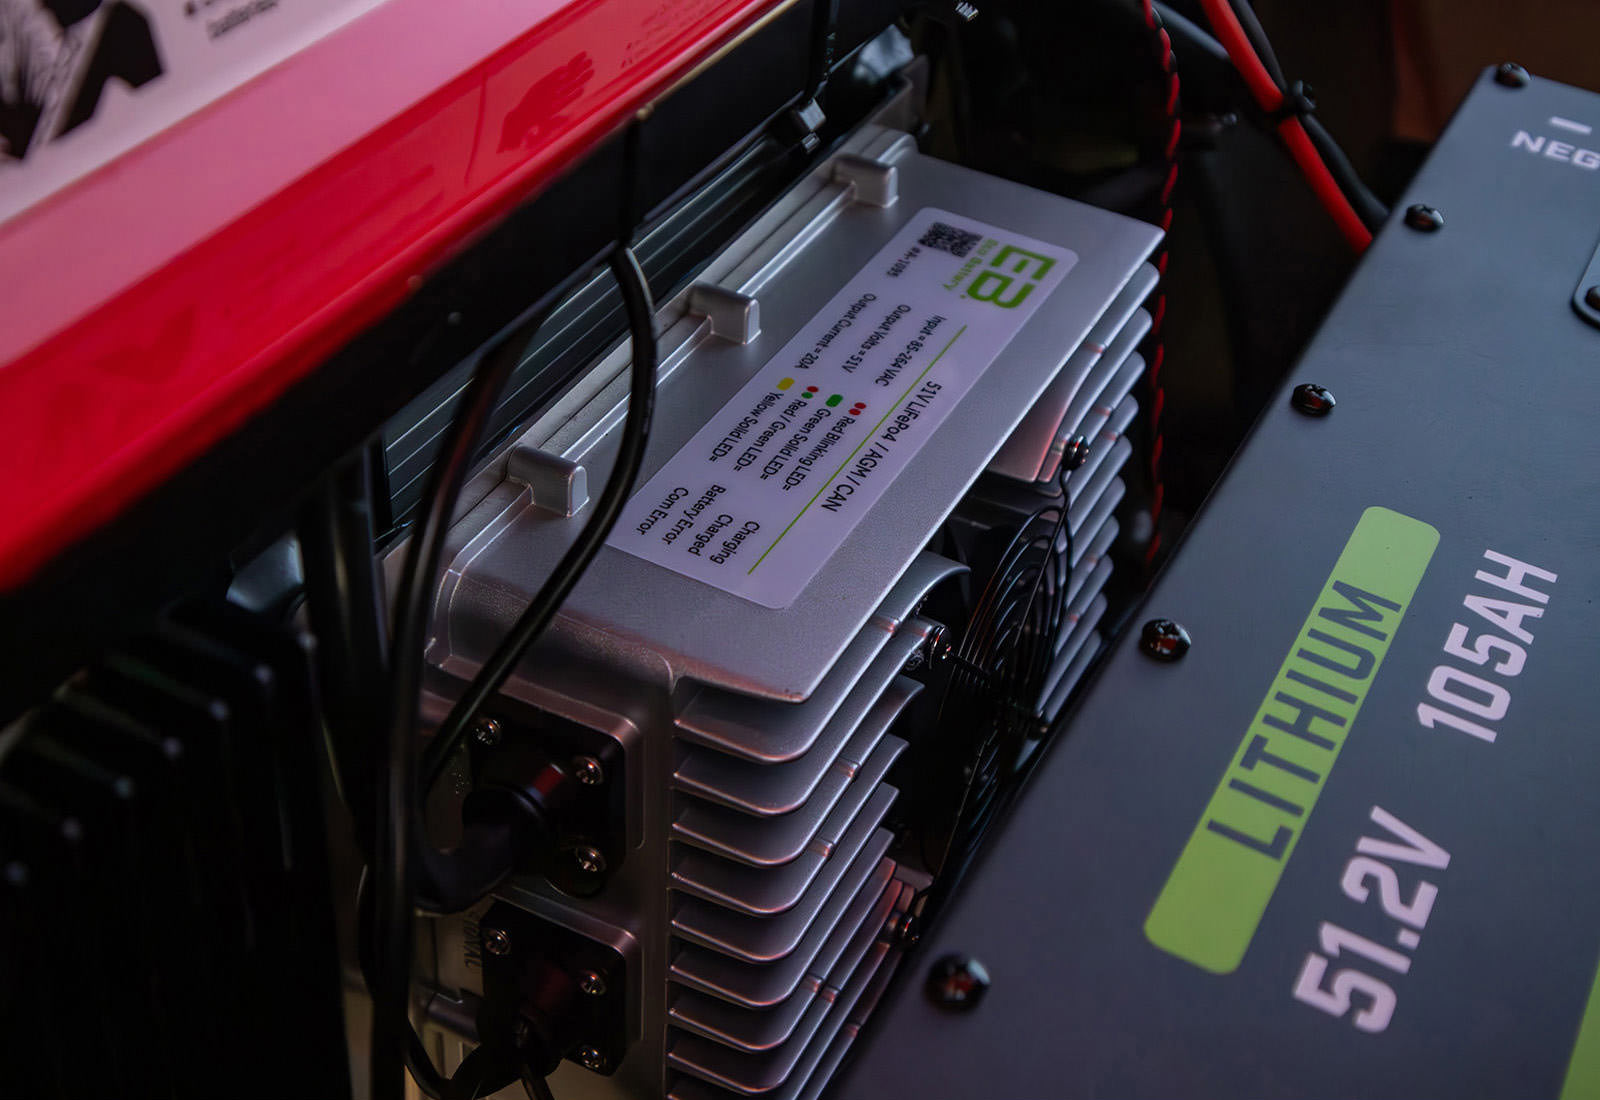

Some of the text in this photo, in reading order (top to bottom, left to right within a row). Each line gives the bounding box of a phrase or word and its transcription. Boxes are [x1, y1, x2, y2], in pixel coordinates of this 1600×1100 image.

[964, 244, 1057, 310] EB
[843, 293, 876, 319] Output
[877, 304, 911, 331] Output
[815, 318, 852, 347] Current
[860, 331, 887, 350] Volts
[919, 315, 946, 335] Input
[794, 352, 818, 369] 20A
[841, 354, 863, 373] 51V
[890, 340, 923, 368] 85-264
[874, 368, 900, 386] VAC
[783, 399, 807, 417] Red
[706, 392, 784, 462] Yellow Solid LED=
[753, 420, 786, 447] Green
[757, 408, 831, 481] Green Solid LED=
[731, 446, 762, 472] LED=
[780, 415, 855, 491] Red Blinking LED=
[820, 380, 942, 512] 51V LiFePo4 / AGM / CAN
[636, 487, 688, 535] Com Error
[662, 484, 726, 545] Battery Error
[687, 514, 733, 556] Charged
[709, 520, 760, 564] Charging
[1417, 549, 1558, 744] 105AH
[1206, 579, 1402, 862] LITHIUM
[1293, 805, 1451, 1033] 51.2V
